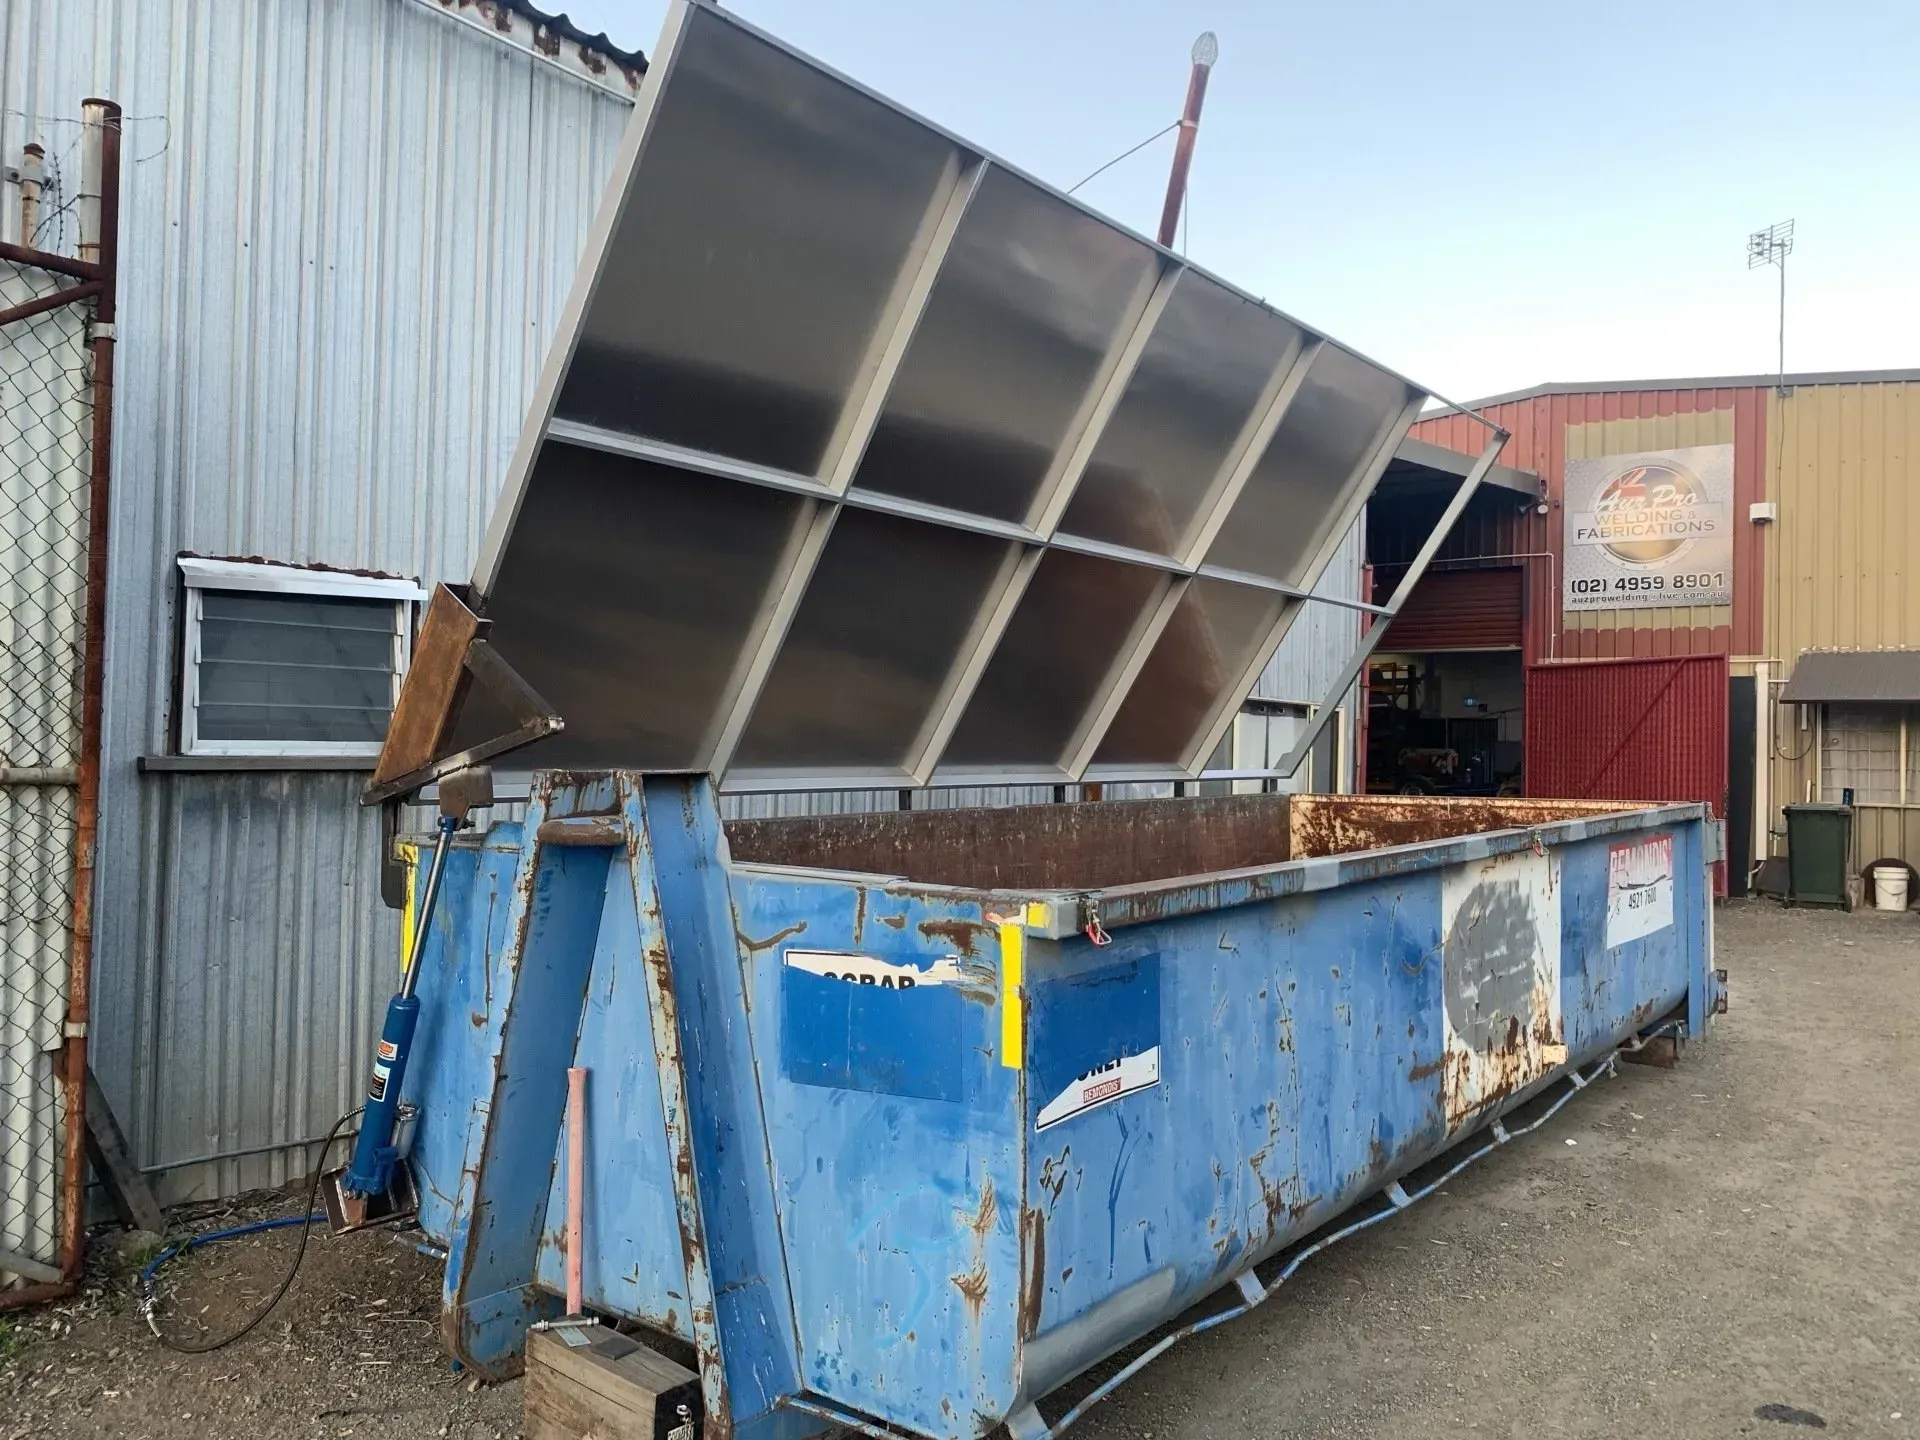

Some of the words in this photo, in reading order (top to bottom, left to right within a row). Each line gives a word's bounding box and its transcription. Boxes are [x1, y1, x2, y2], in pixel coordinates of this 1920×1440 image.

[1594, 488, 1648, 513] Auz
[1652, 484, 1699, 509] Pro
[1595, 509, 1682, 526] WELDING
[1687, 510, 1697, 520] &
[1577, 520, 1715, 540] FABRICATIONS
[1571, 578, 1607, 593] (02)
[1614, 576, 1665, 591] 4959
[1673, 573, 1724, 588] 8901
[1628, 891, 1643, 909] 4921
[1084, 1079, 1119, 1102] REMONDIS
